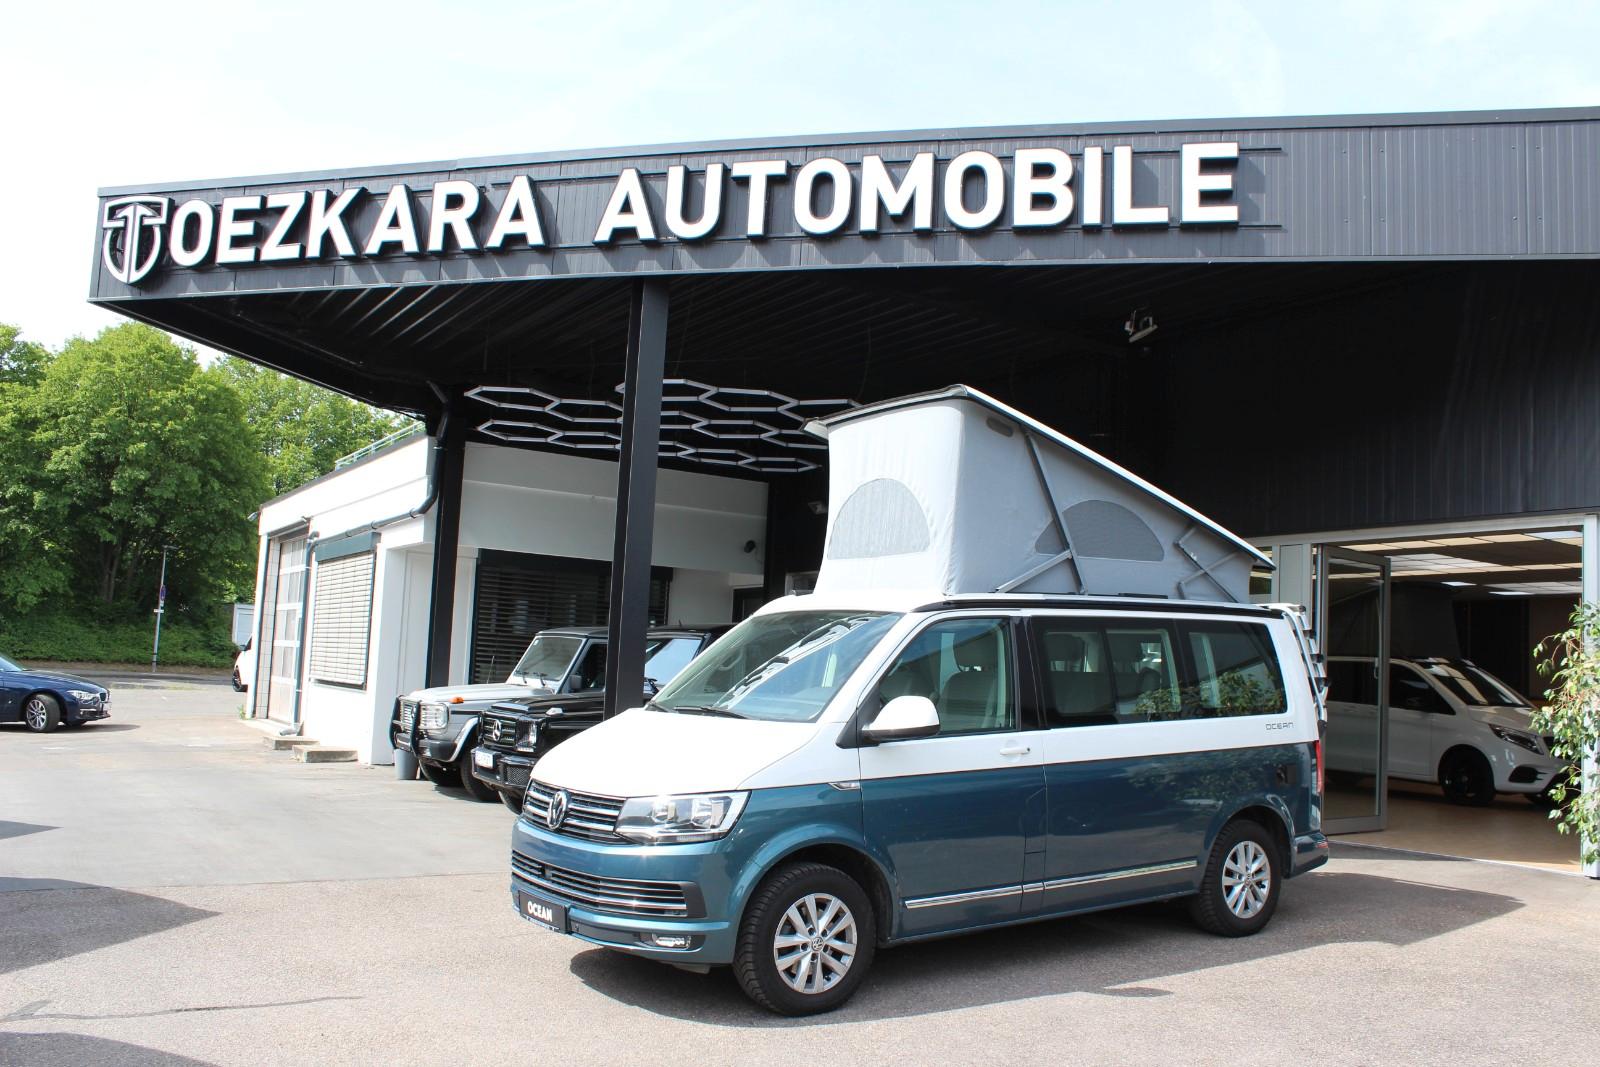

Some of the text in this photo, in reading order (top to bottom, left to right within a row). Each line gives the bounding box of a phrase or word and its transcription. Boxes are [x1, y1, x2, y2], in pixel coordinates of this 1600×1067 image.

[593, 141, 1240, 245] AUTOMOBILE
[1265, 722, 1294, 731] OCEAN
[527, 900, 553, 922] OCEAN
